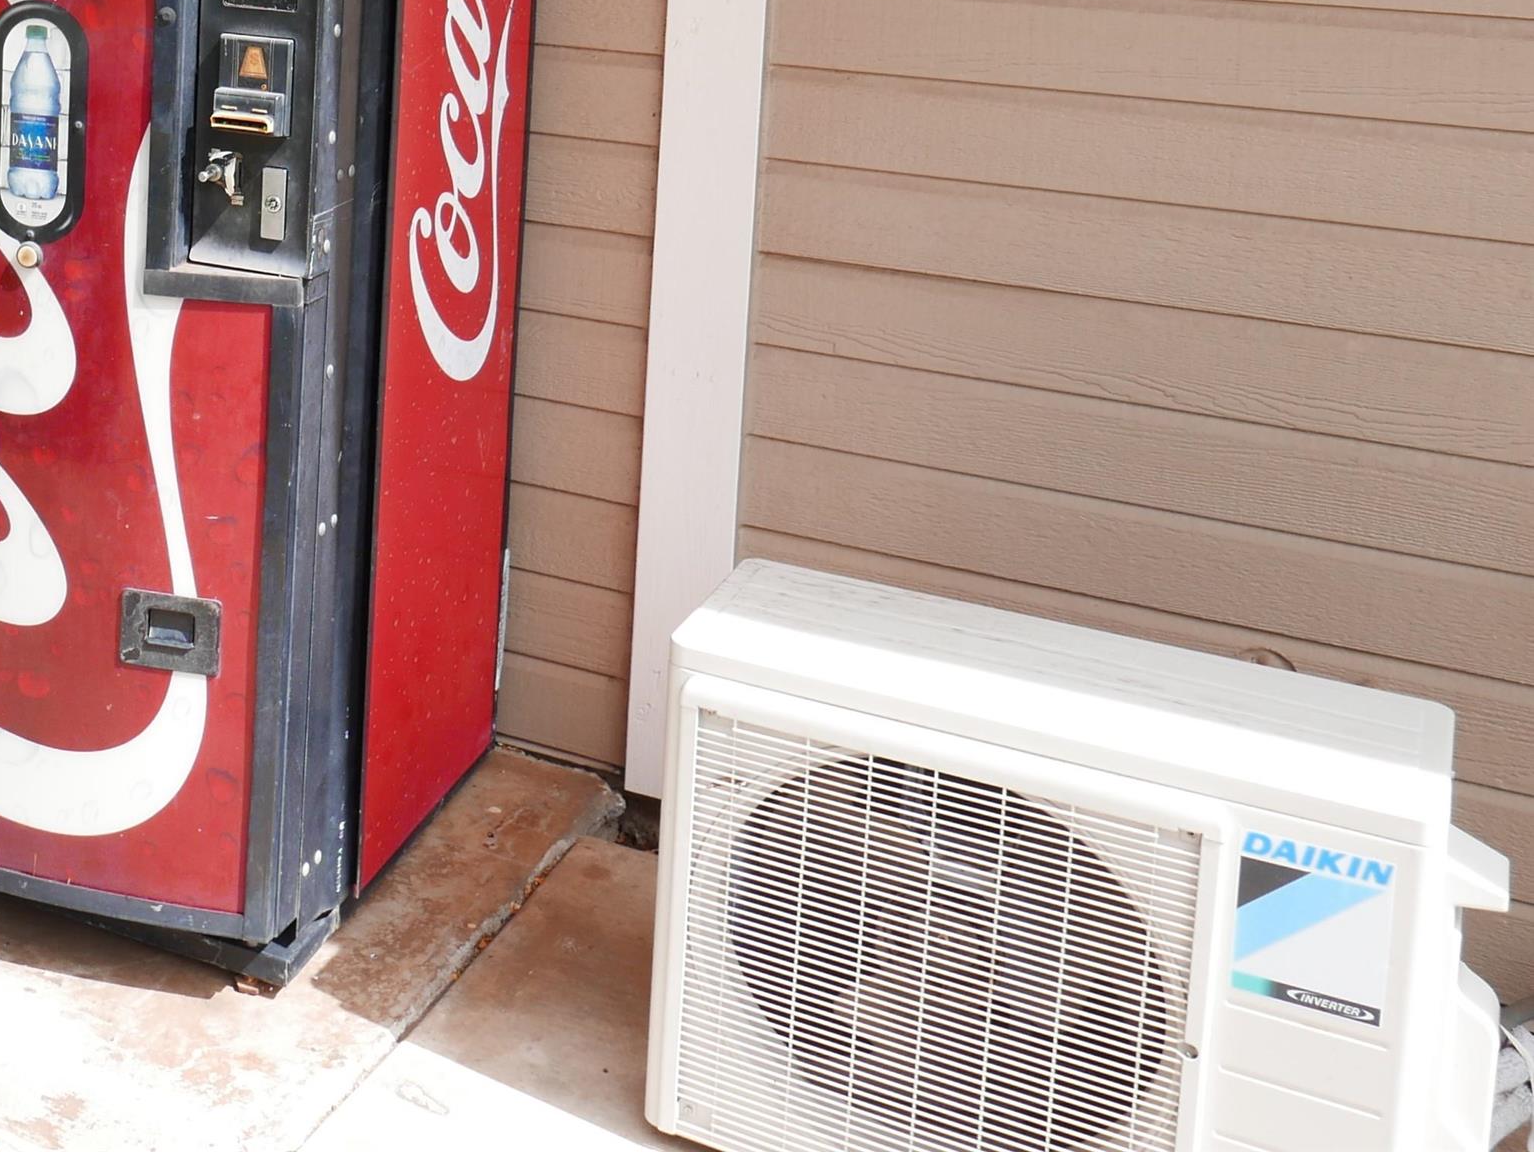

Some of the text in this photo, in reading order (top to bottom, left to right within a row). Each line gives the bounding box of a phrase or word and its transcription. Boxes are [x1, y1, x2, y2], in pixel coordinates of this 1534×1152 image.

[12, 133, 57, 151] DASANI
[1242, 831, 1395, 886] DAIKIN
[1300, 991, 1362, 1018] INVERTER
